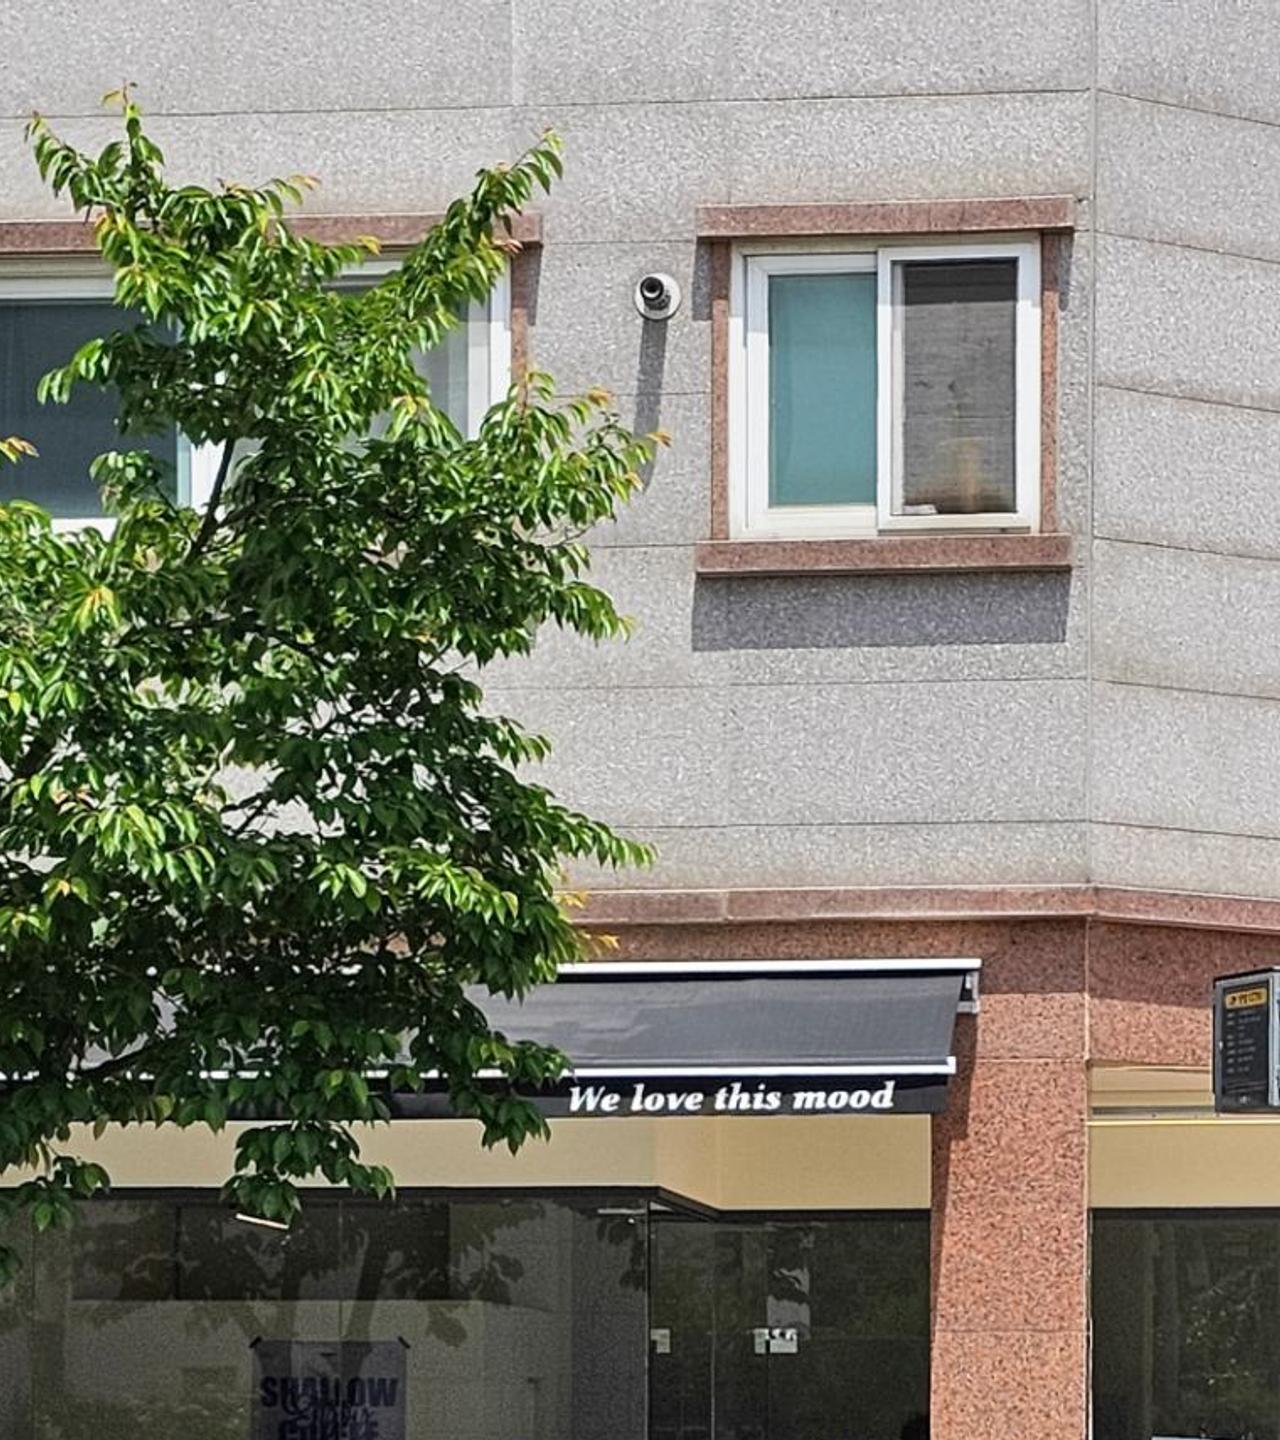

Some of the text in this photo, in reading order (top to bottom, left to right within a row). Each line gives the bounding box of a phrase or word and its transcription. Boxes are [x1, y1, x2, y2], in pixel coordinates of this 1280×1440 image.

[568, 1080, 895, 1113] We love this mood
